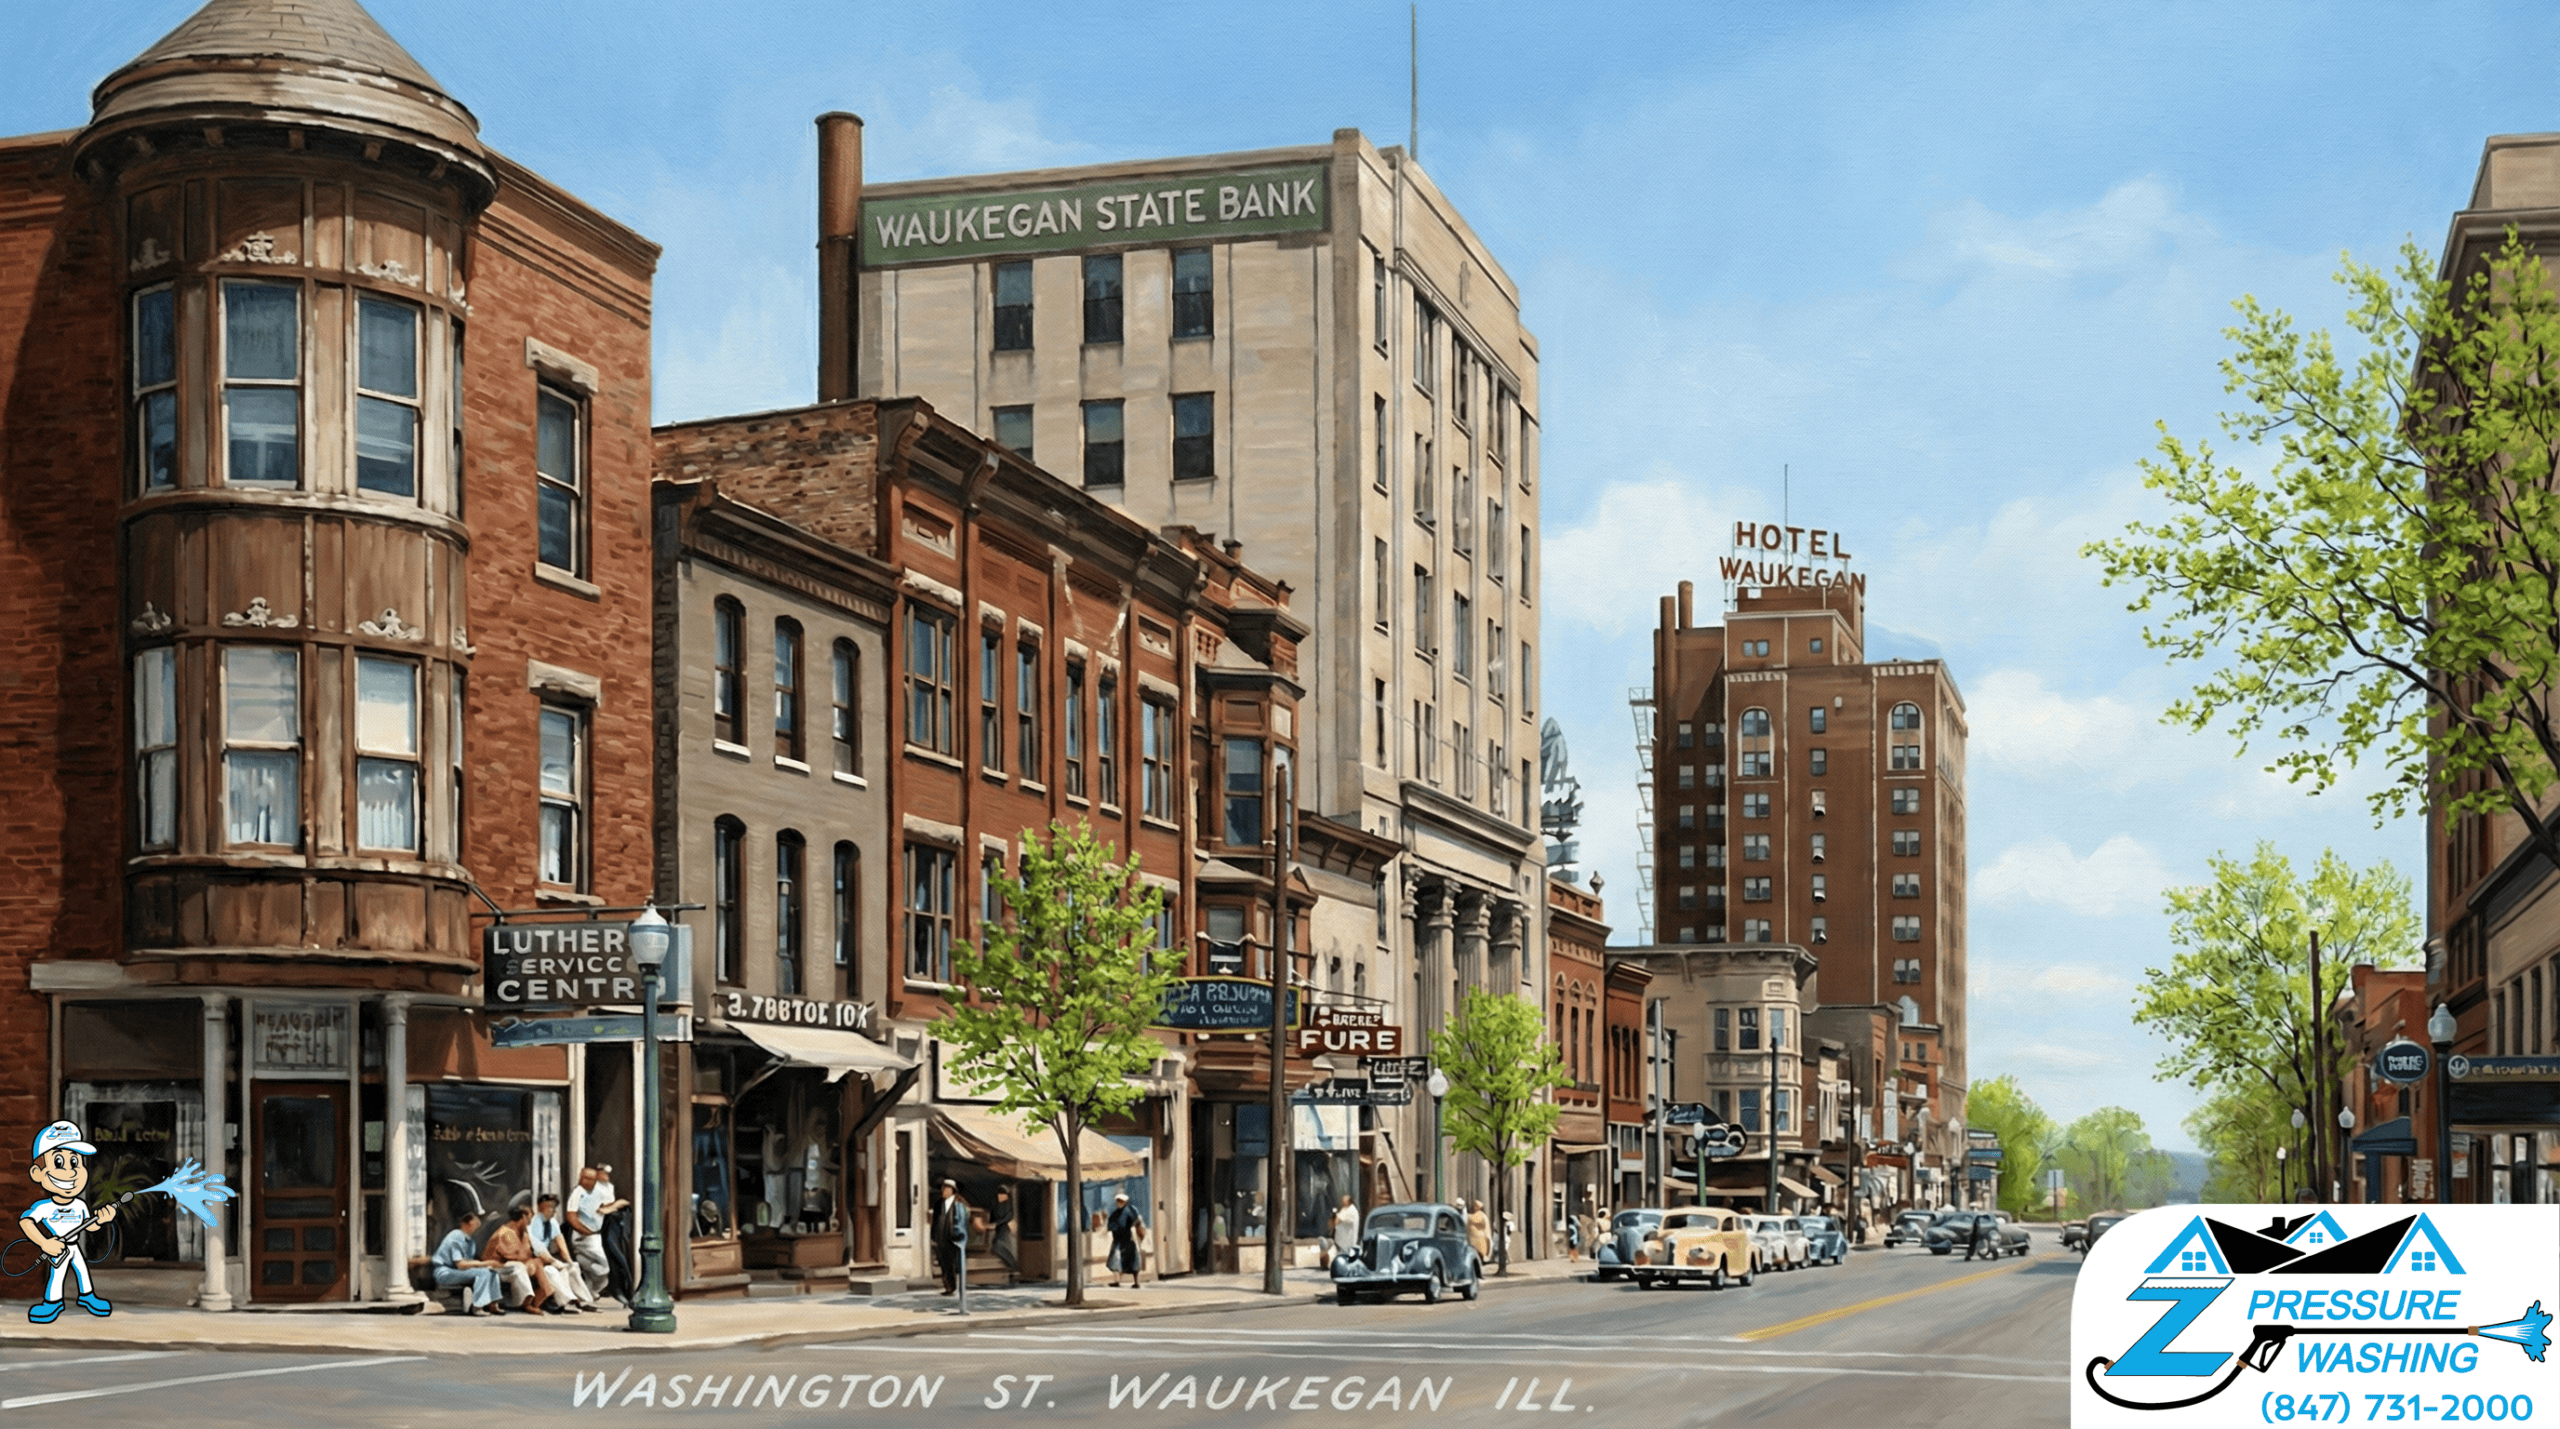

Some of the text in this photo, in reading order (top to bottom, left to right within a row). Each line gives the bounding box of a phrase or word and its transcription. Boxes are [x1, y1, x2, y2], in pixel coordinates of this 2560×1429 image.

[876, 178, 1317, 248] WAUKEGAN STATE BANK
[1736, 521, 1851, 559] HOTEL
[1719, 556, 1866, 600] WAUKEGAN
[1300, 1029, 1397, 1051] FURE
